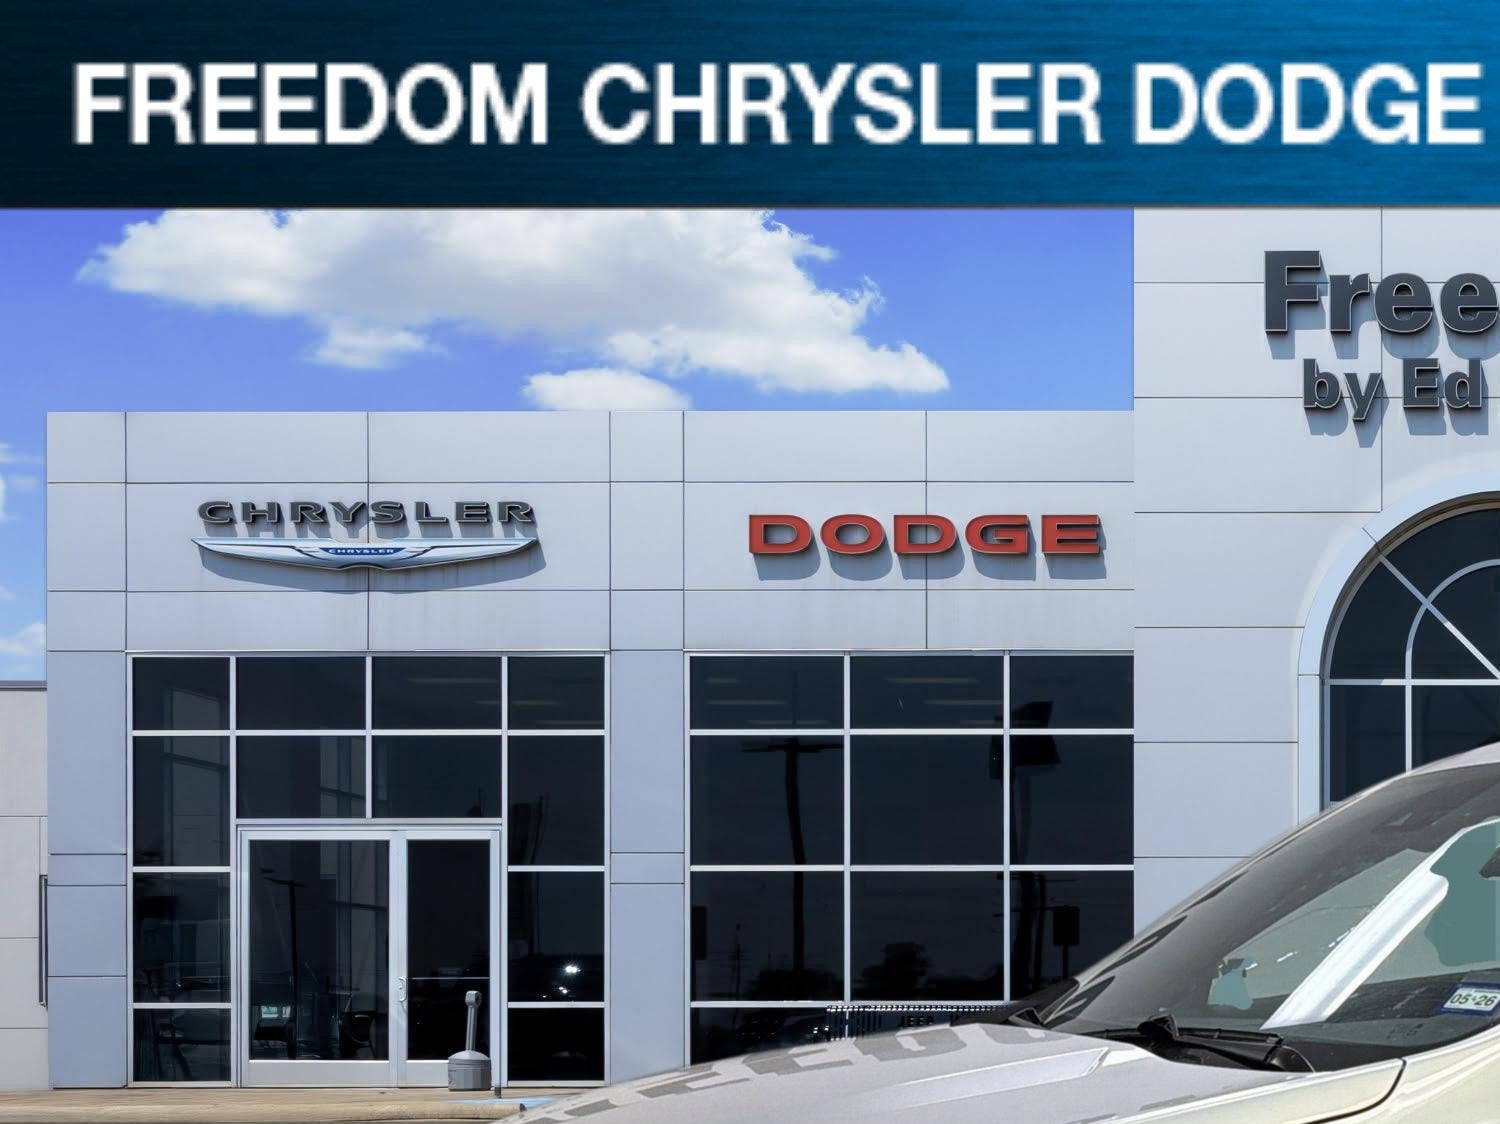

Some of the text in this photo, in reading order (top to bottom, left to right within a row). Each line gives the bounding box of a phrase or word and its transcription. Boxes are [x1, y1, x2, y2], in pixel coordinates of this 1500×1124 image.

[1303, 358, 1382, 420] by
[1403, 358, 1482, 408] Ed
[197, 500, 536, 524] CHRYSLER
[748, 513, 1102, 556] DODGE
